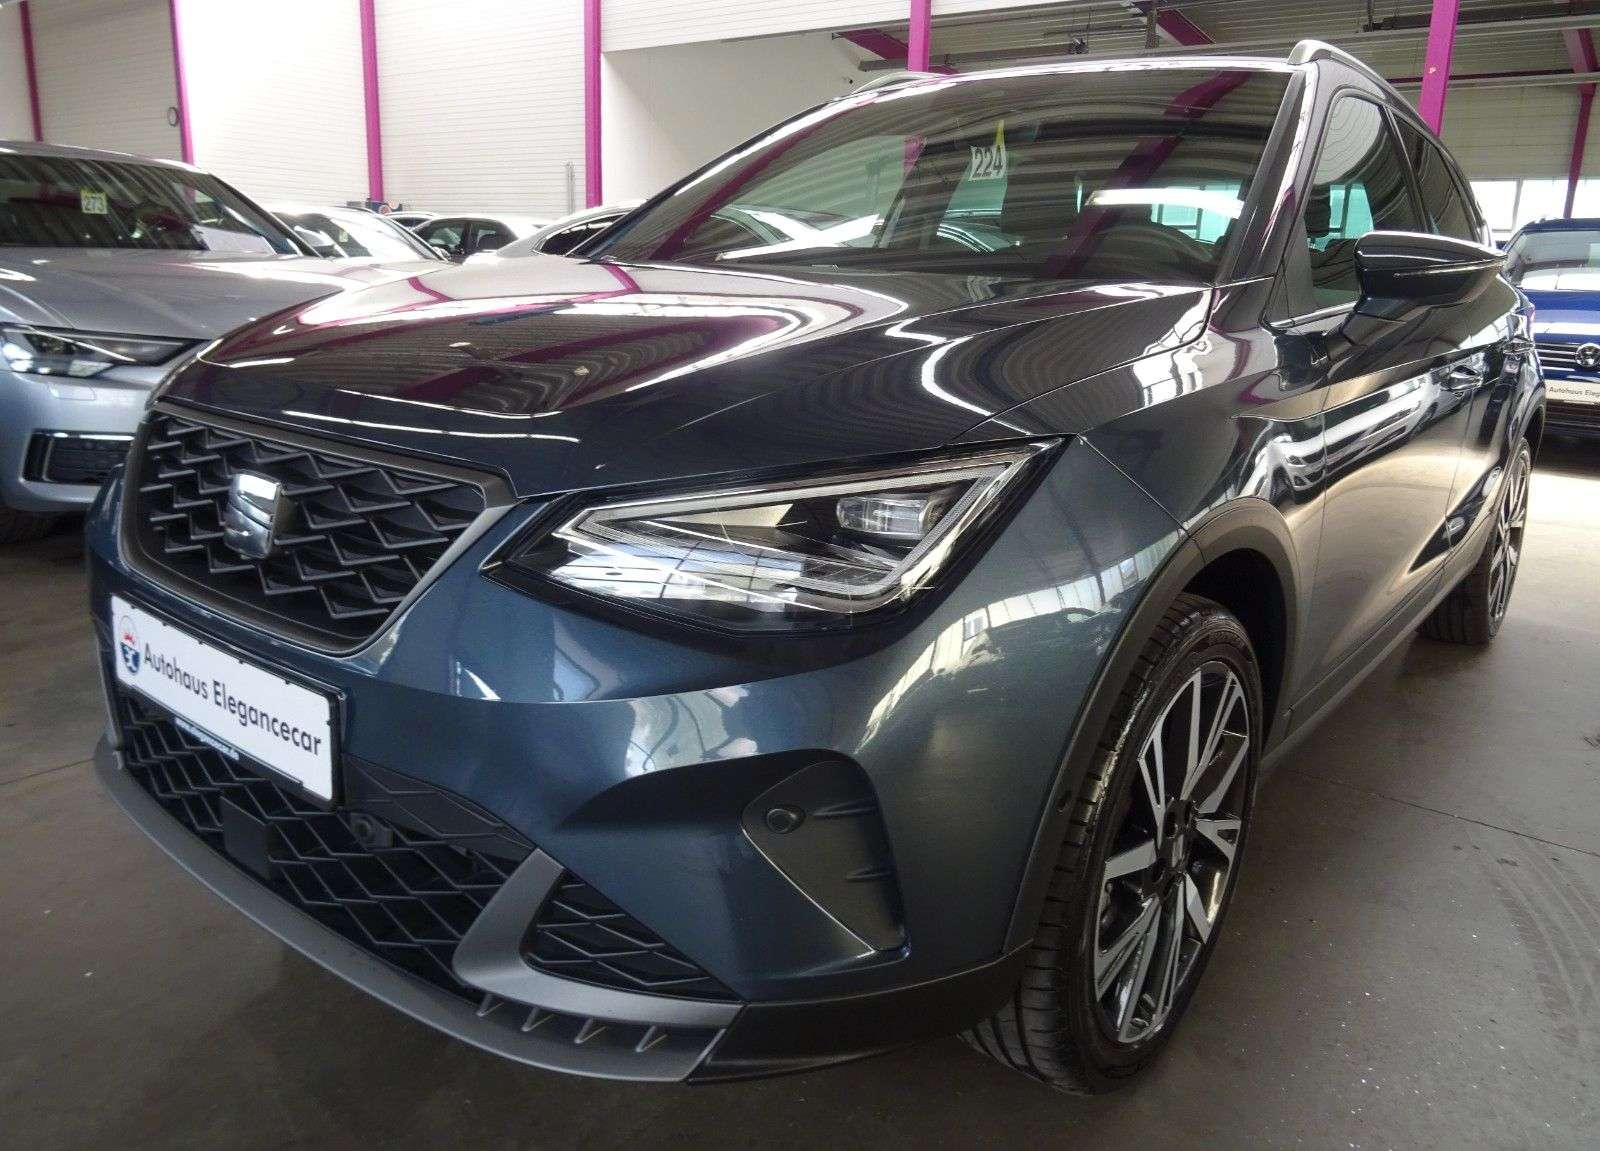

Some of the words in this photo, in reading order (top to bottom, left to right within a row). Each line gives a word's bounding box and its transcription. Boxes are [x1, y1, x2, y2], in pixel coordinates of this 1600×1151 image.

[972, 145, 1004, 178] 224
[144, 642, 208, 701] Autohaus
[213, 679, 322, 756] Elegancecar
